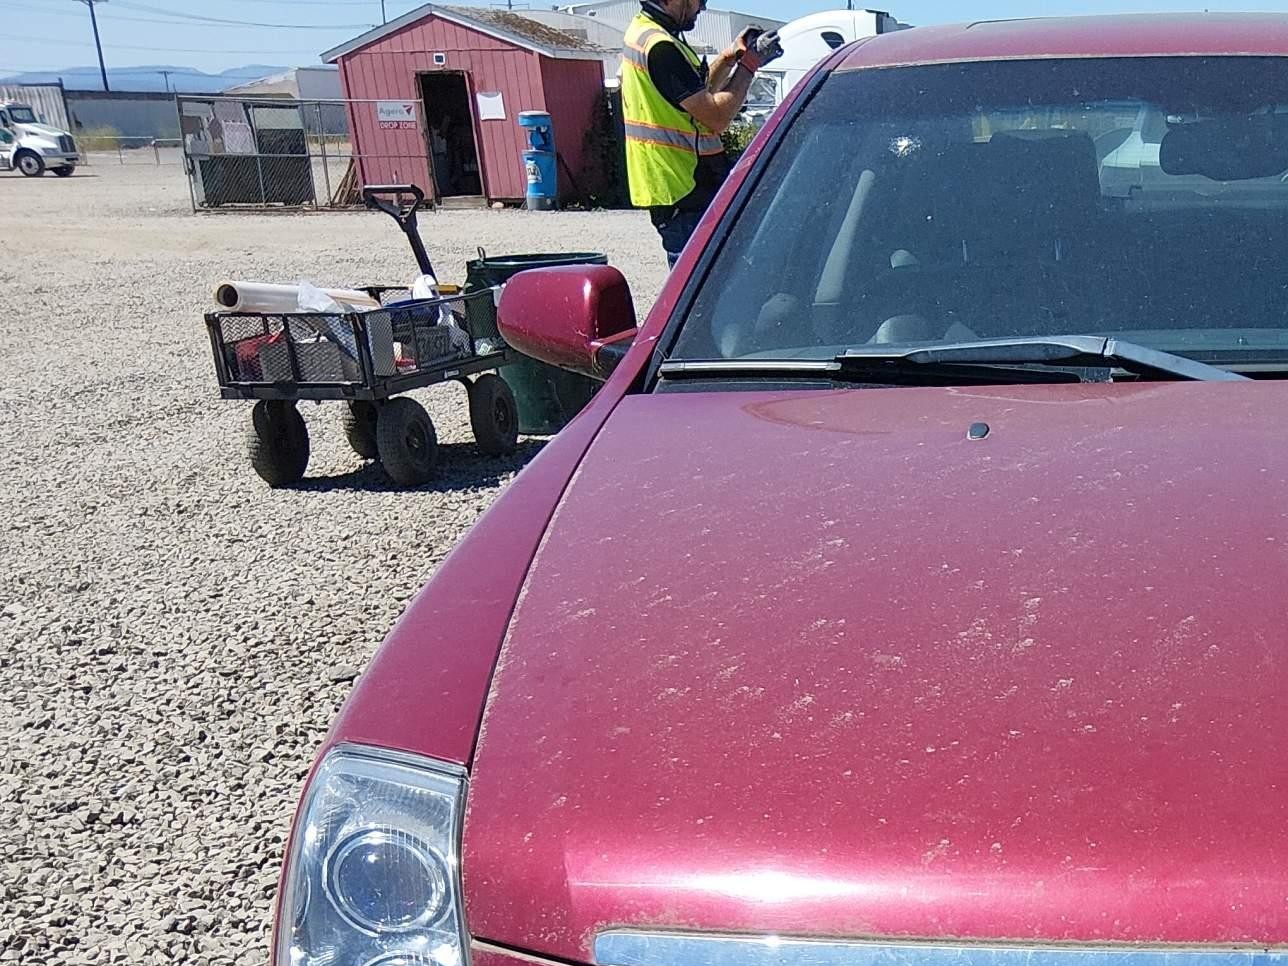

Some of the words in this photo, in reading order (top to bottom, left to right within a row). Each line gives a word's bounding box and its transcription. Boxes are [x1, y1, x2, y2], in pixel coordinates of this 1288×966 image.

[379, 107, 405, 117] Agero
[380, 121, 398, 129] DROP
[399, 121, 417, 129] ZONE
